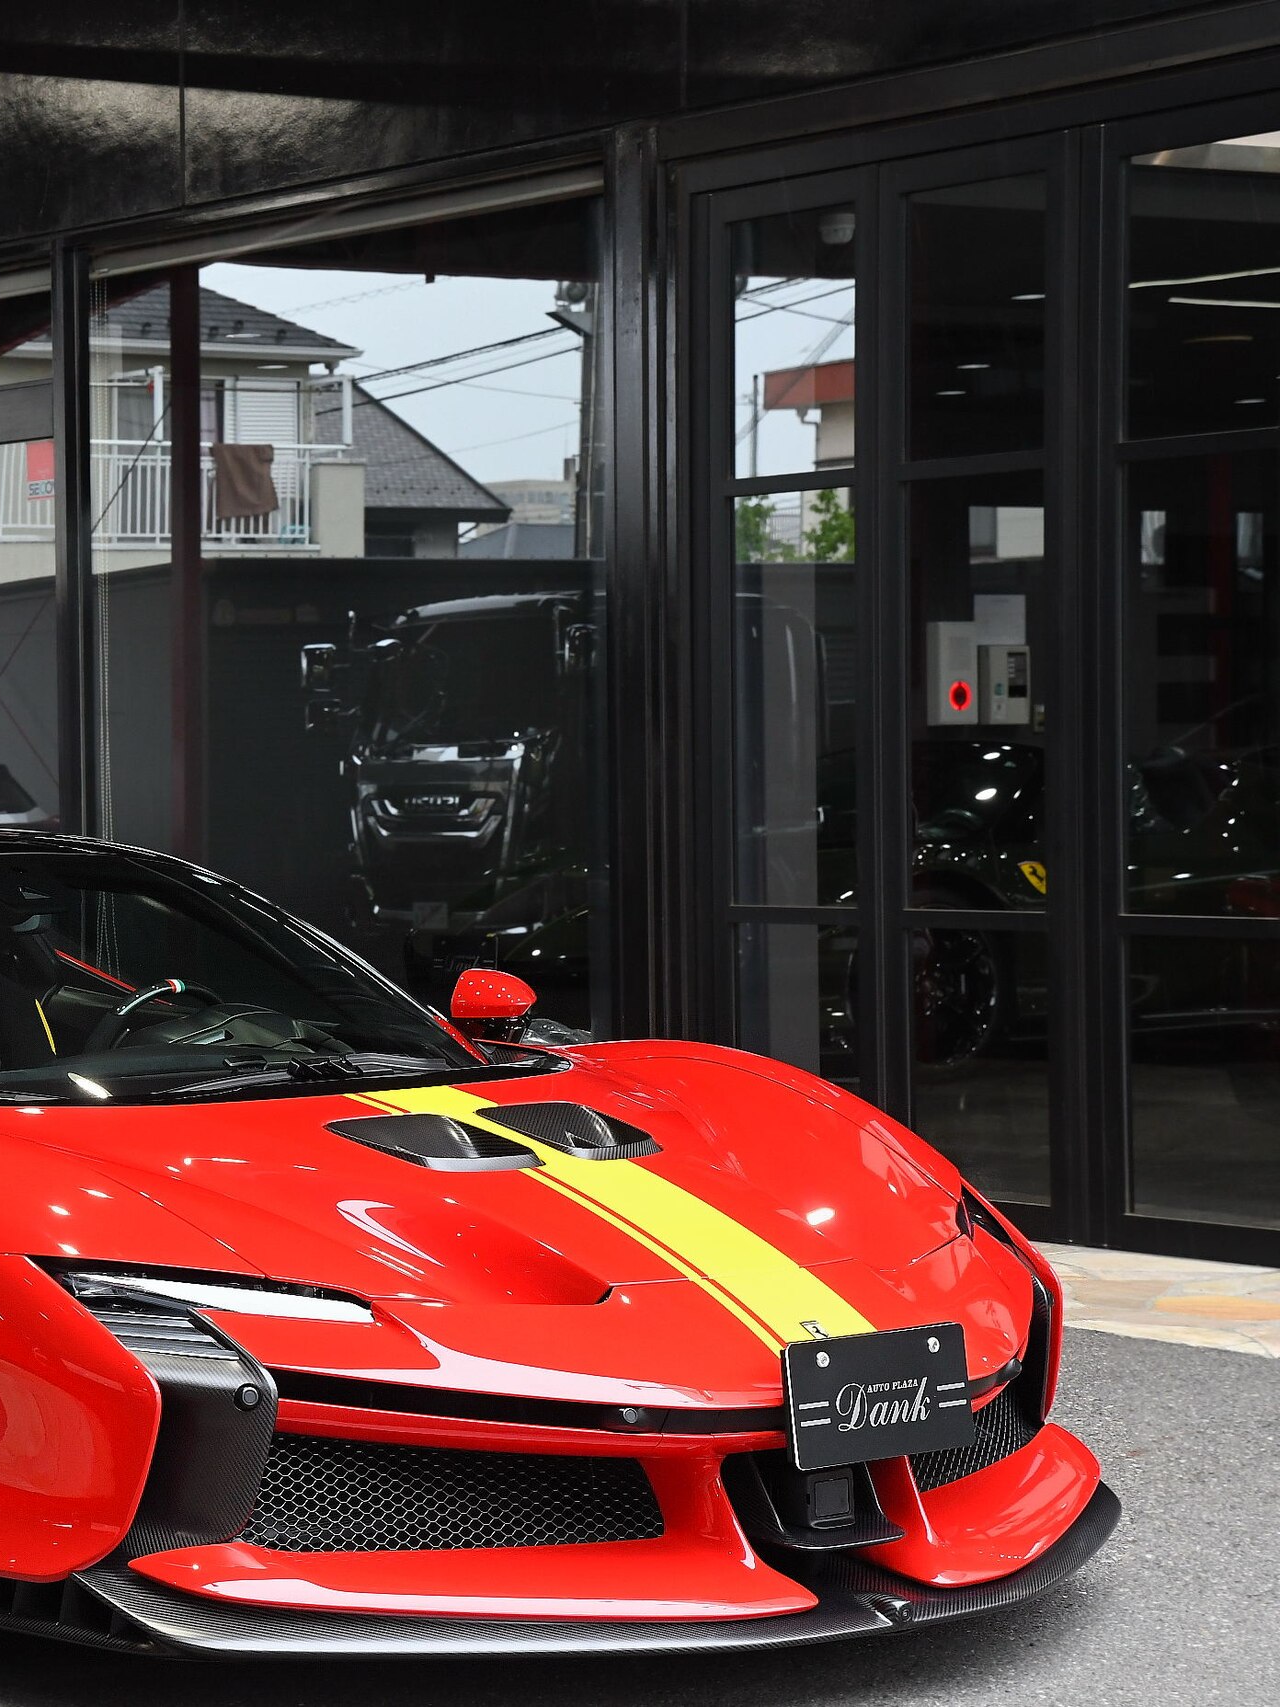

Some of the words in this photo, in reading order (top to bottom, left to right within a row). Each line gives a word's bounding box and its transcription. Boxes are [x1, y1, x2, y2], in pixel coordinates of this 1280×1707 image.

[28, 480, 55, 496] SECO
[866, 1382, 890, 1394] AUTO
[891, 1378, 919, 1391] PLAZA
[836, 1376, 931, 1432] Dank
